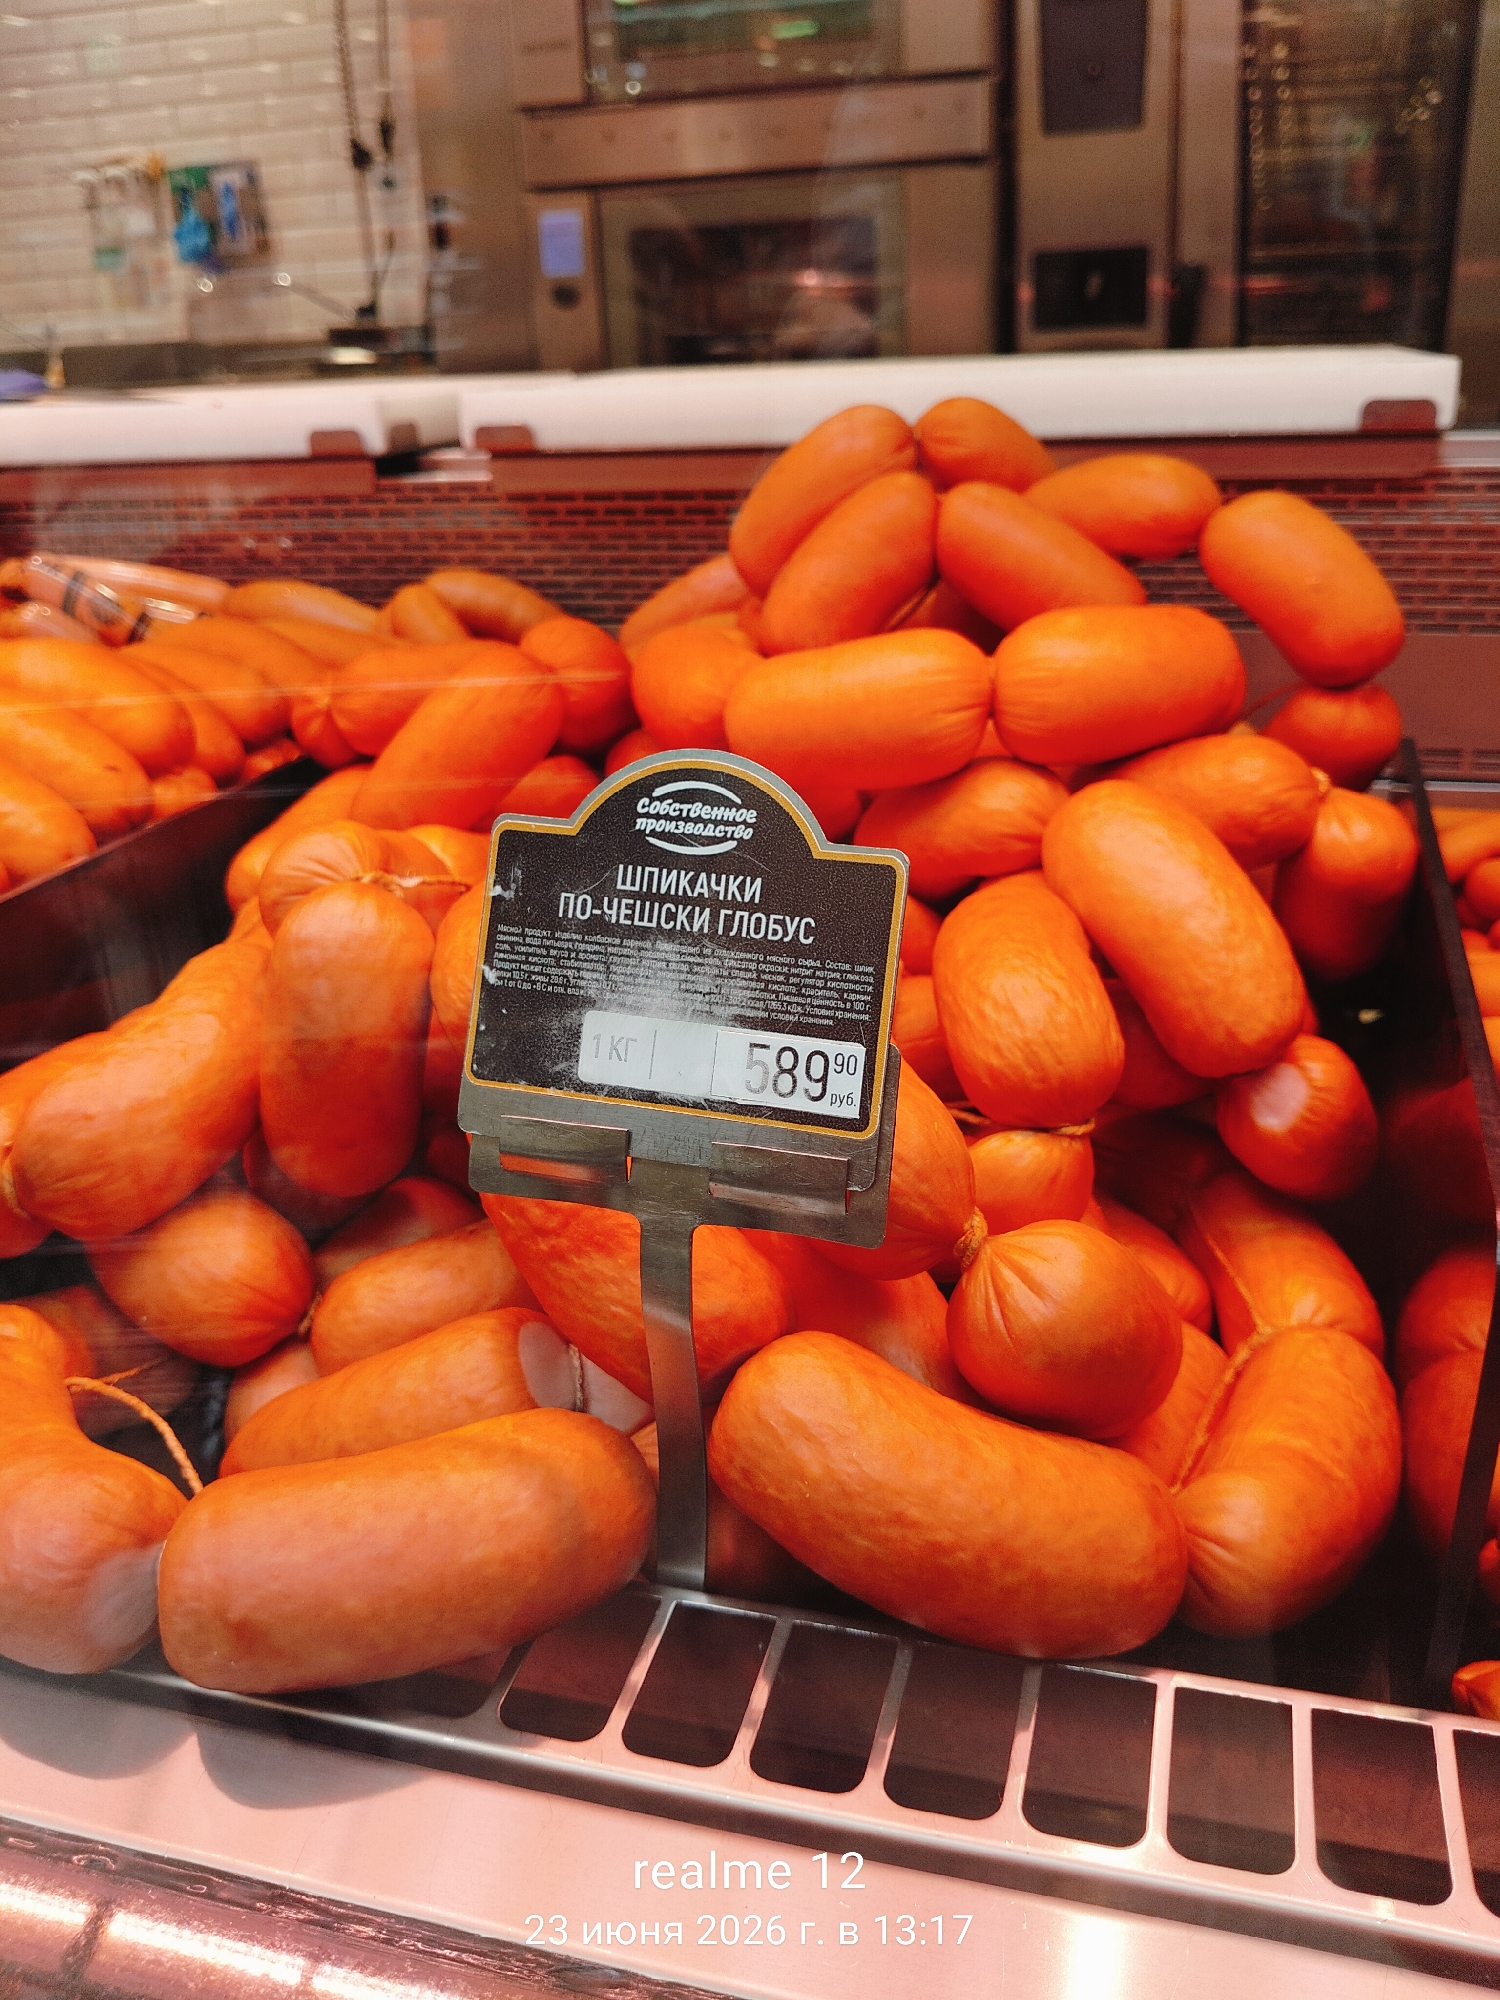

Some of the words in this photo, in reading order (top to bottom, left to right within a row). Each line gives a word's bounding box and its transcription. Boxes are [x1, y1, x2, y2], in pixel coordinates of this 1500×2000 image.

[636, 797, 757, 824] Собственное
[635, 815, 753, 841] производство
[616, 864, 762, 904] ШПИКАЧКИ
[558, 892, 710, 934] ПО-ЧЕШСКИ
[717, 910, 816, 945] ГЛОБУС
[592, 1033, 602, 1060] 1
[608, 1035, 637, 1064] КГ
[745, 1042, 830, 1103] 589
[834, 1055, 858, 1077] 90
[830, 1092, 857, 1108] руб.
